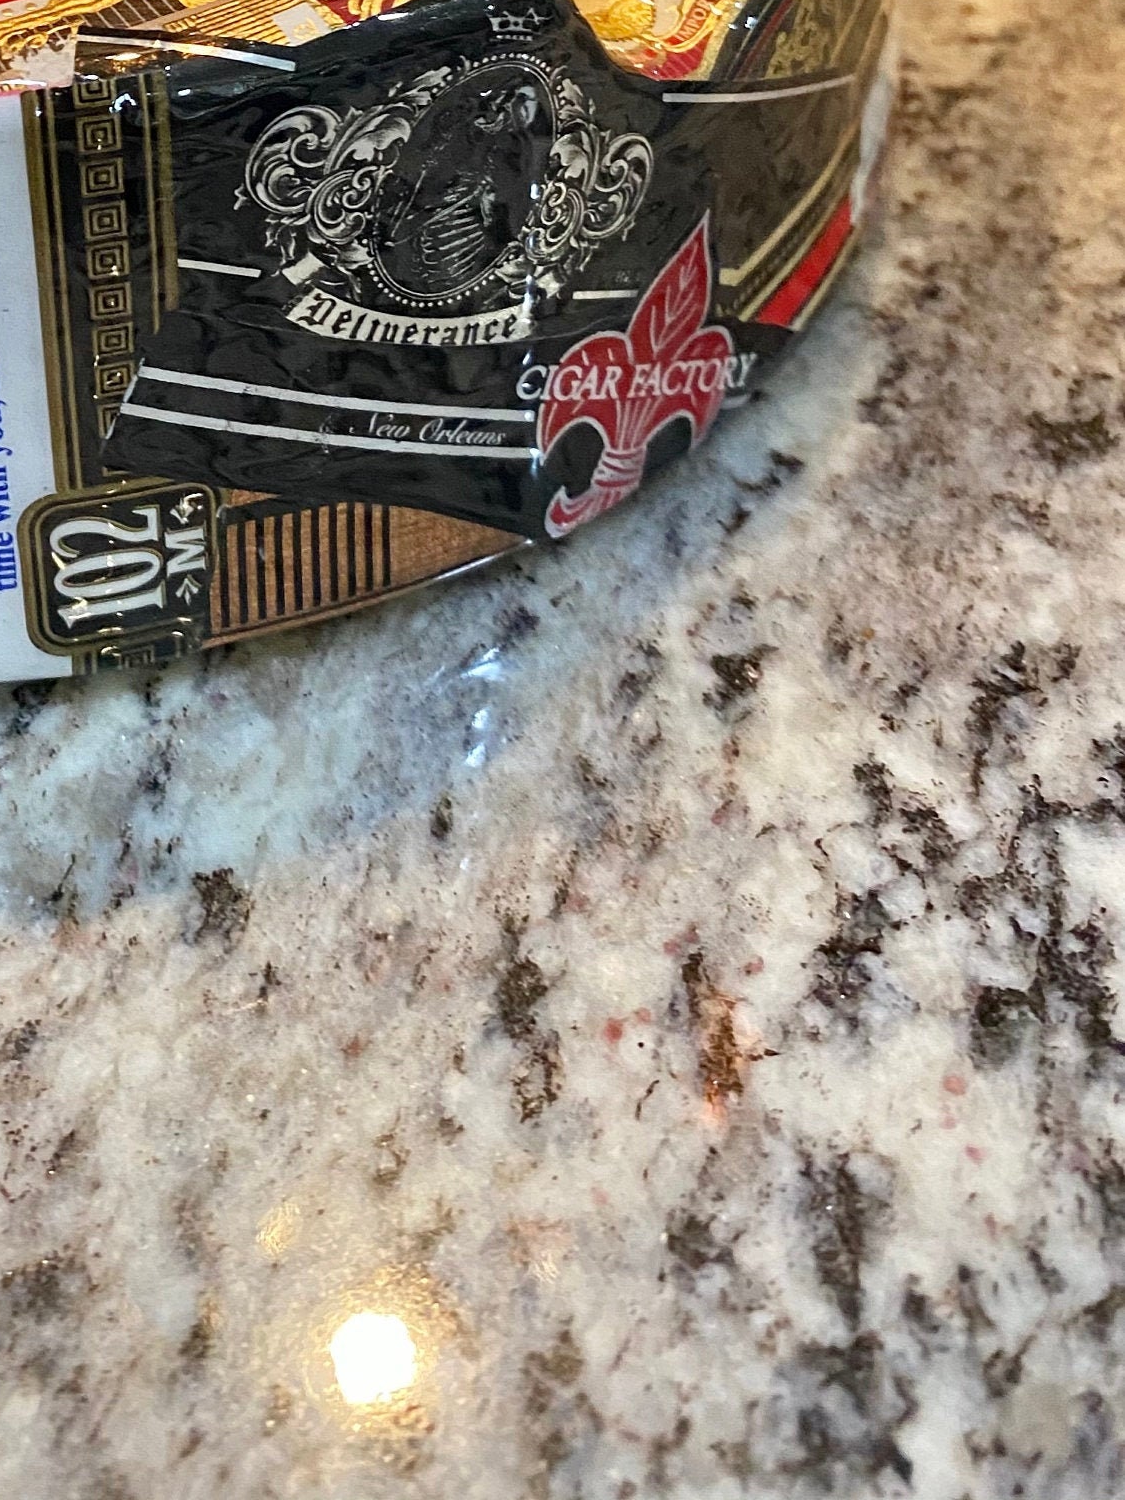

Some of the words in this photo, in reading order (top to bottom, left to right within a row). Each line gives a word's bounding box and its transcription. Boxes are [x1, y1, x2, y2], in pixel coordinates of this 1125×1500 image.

[299, 292, 516, 346] Deliverance
[516, 363, 623, 402] CIGAR
[627, 352, 758, 400] FACTORY
[350, 412, 409, 440] New
[419, 417, 506, 446] Orleans
[49, 503, 166, 630] 102
[164, 525, 208, 578] M
